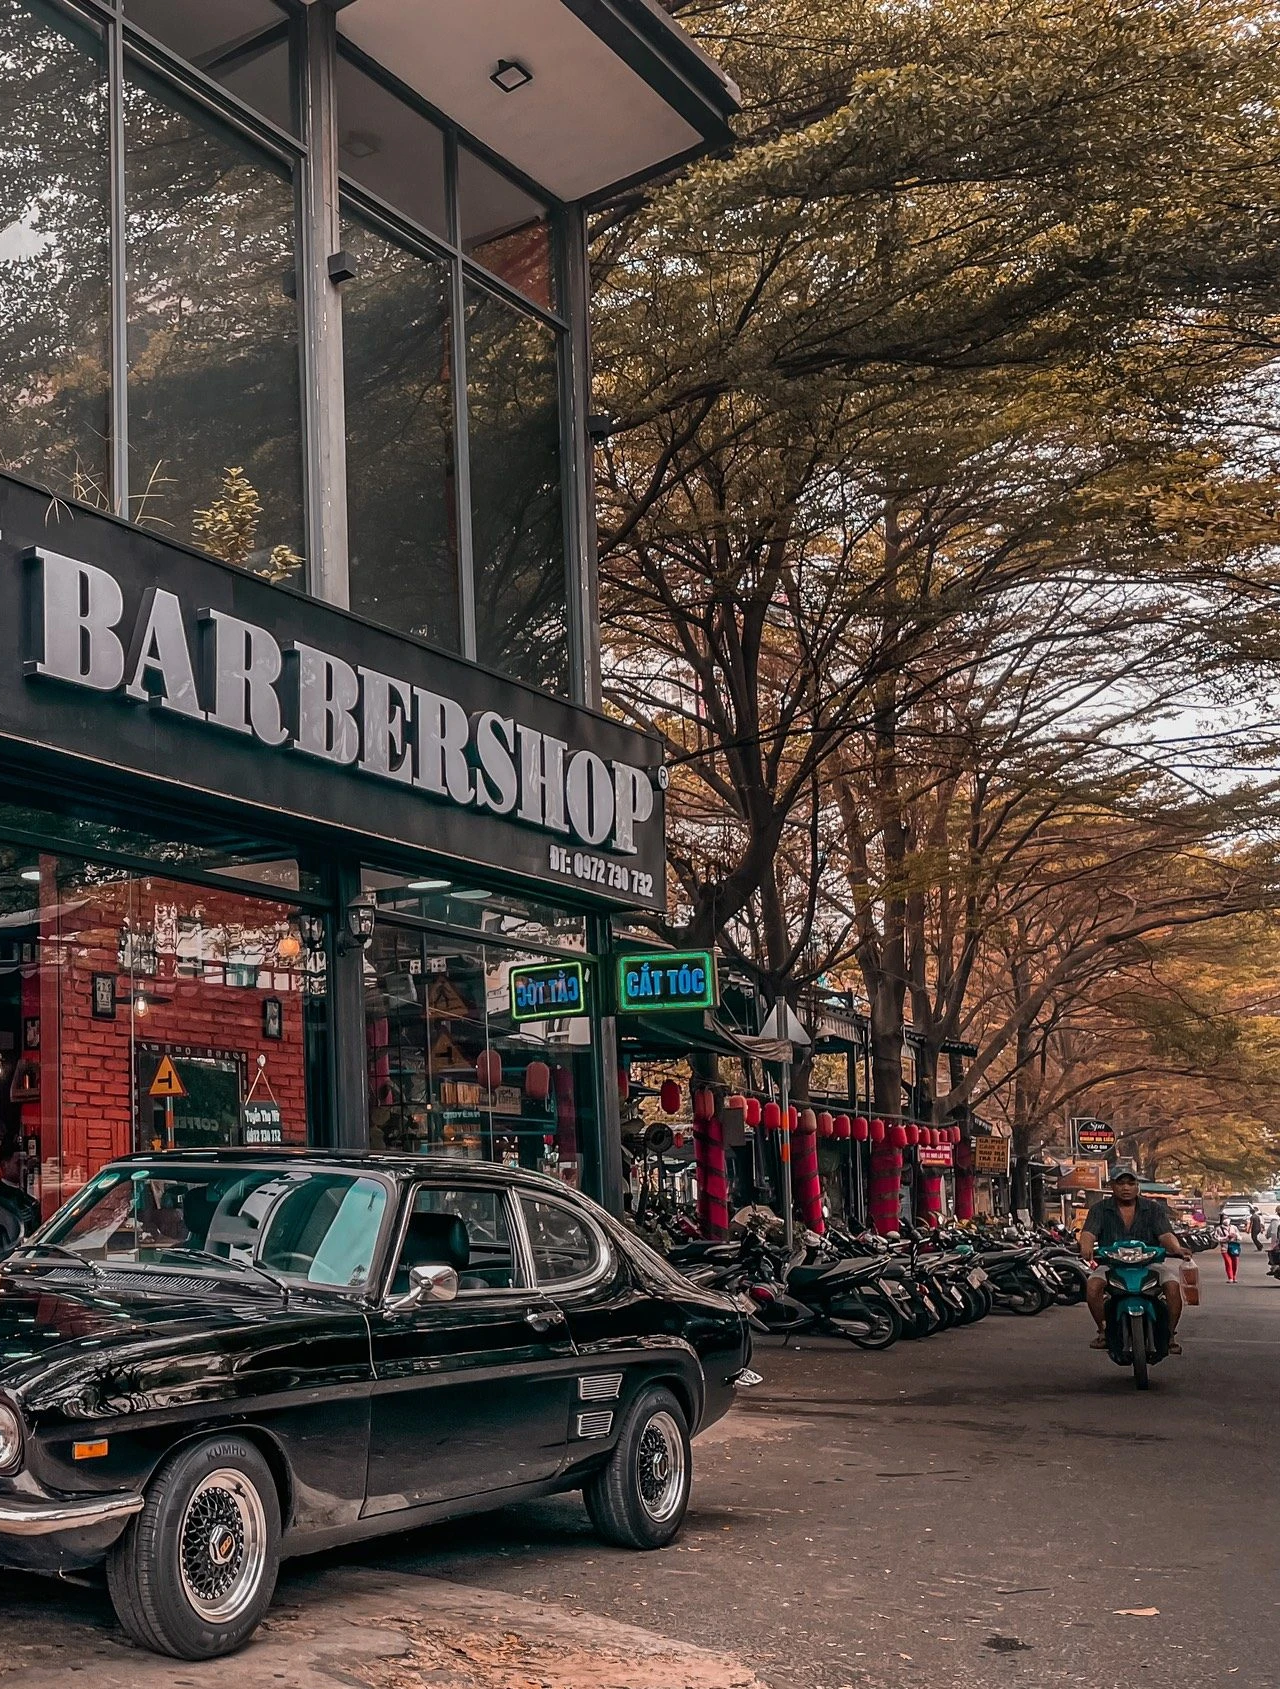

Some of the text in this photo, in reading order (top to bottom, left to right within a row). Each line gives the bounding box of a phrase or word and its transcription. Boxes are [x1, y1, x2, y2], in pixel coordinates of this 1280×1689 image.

[24, 545, 653, 856] BARBERSHOP
[574, 852, 606, 885] 0972
[607, 862, 629, 891] 730
[630, 869, 654, 898] 732
[626, 962, 706, 998] CẮT TÓC
